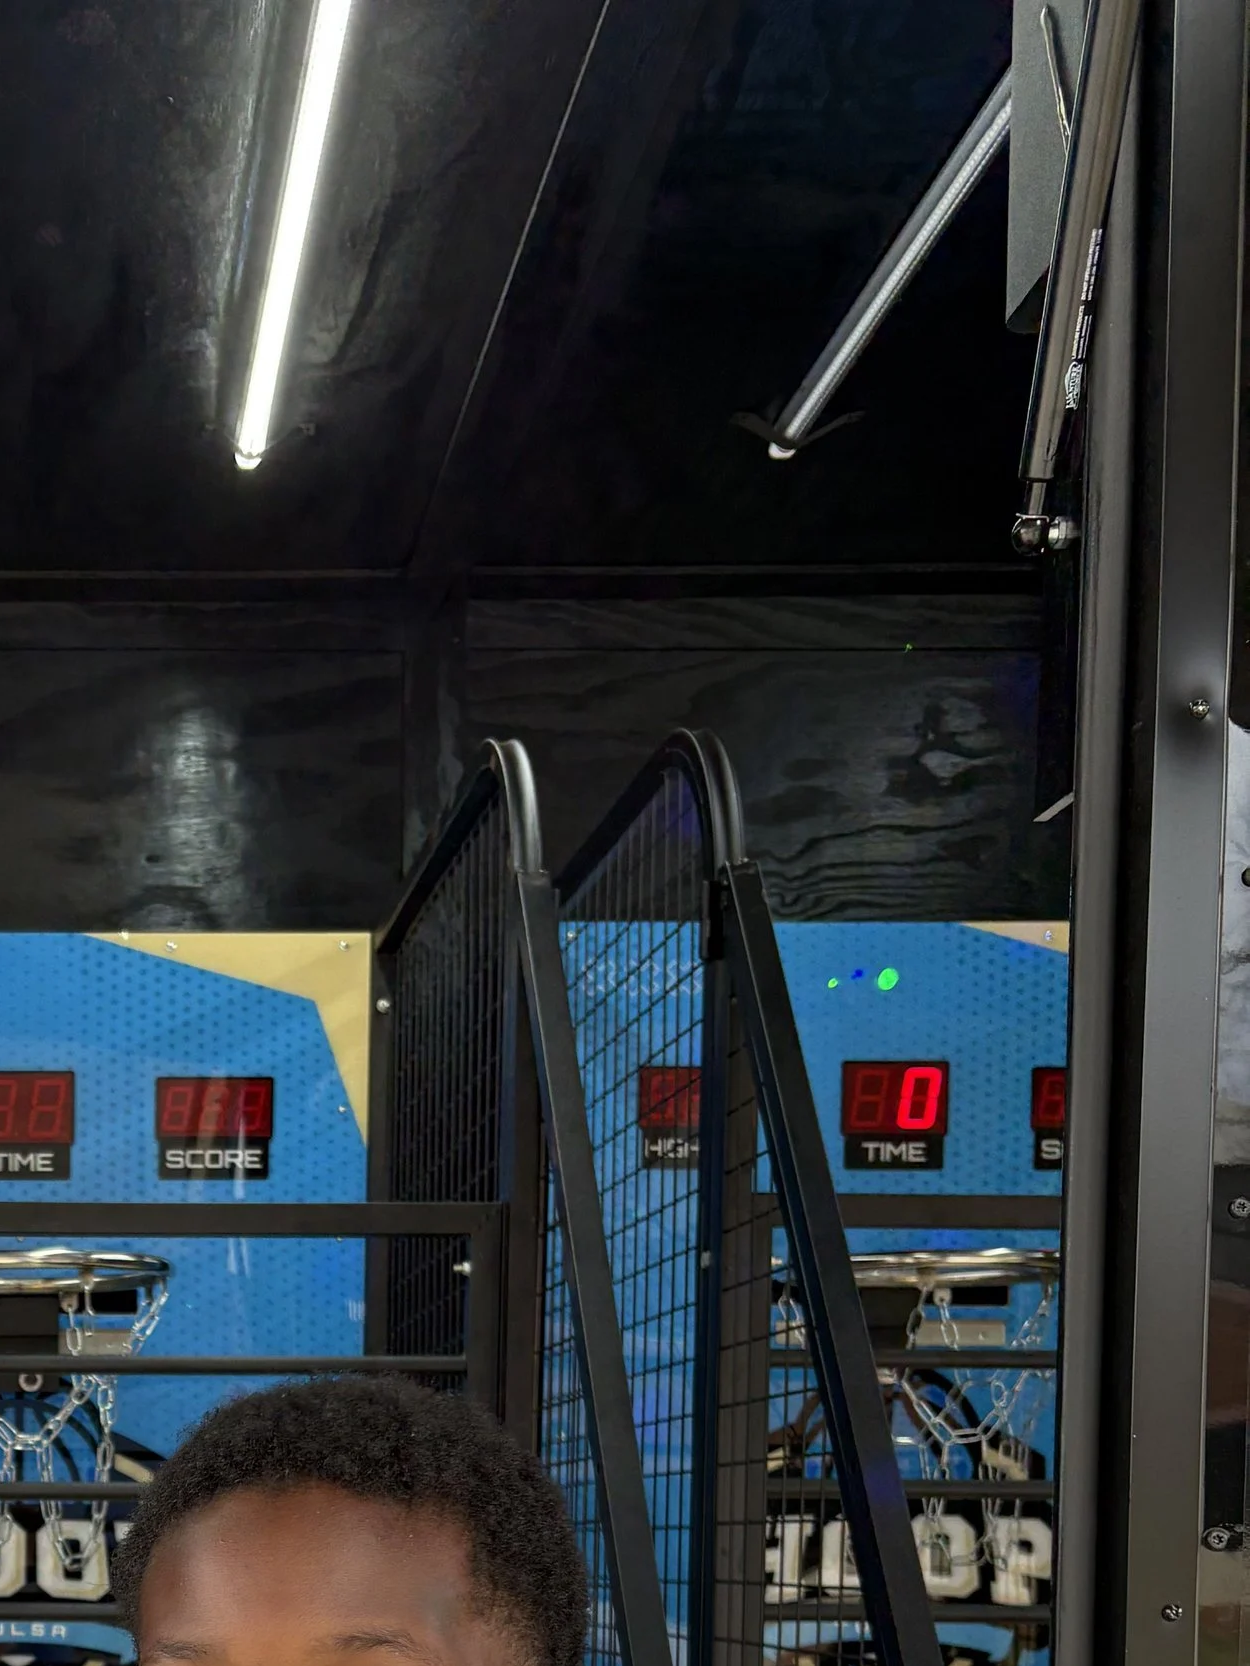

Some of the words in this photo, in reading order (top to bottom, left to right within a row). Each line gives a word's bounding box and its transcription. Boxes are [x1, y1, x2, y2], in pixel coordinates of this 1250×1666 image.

[896, 1066, 943, 1130] 0
[165, 1149, 264, 1170] SCORE
[861, 1141, 928, 1163] TIME
